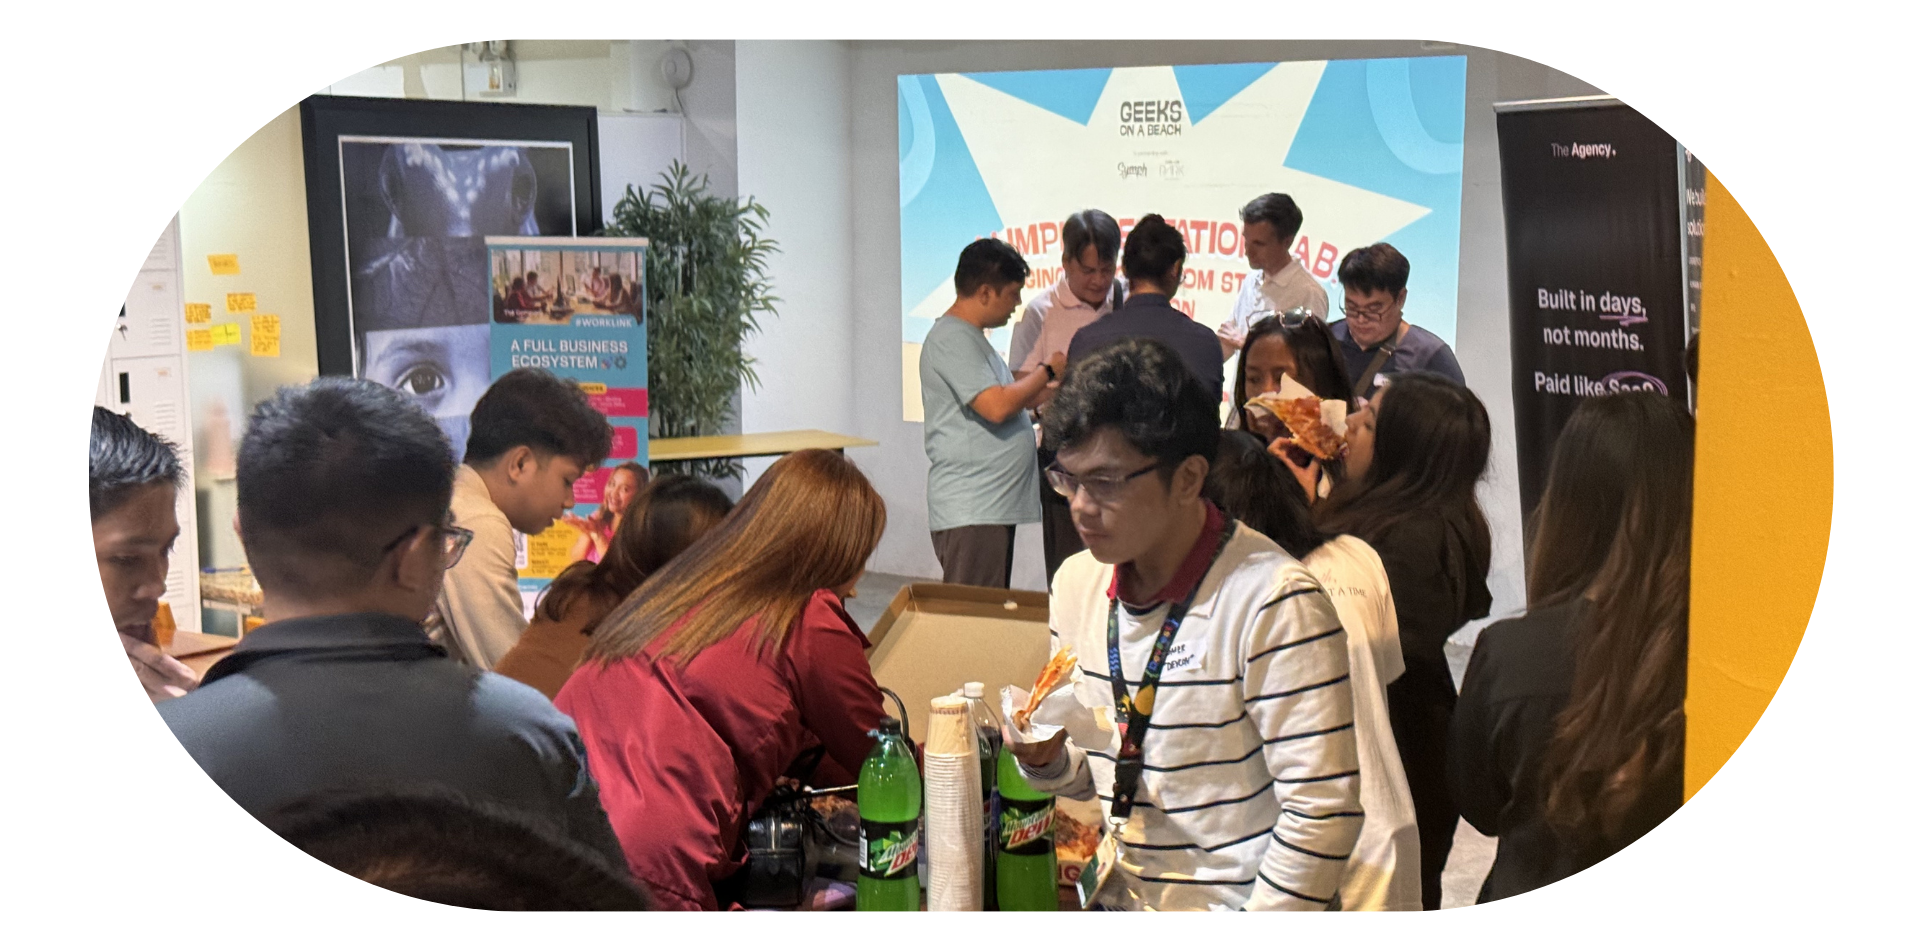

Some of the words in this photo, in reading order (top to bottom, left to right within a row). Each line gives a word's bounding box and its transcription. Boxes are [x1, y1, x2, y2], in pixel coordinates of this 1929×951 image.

[1120, 100, 1182, 123] GEEKS
[1120, 124, 1135, 136] ON
[1137, 124, 1145, 136] A
[1147, 124, 1182, 136] BEACH
[1551, 142, 1569, 157] The
[1571, 142, 1617, 159] Agency.
[1294, 235, 1338, 284] AB.
[1537, 288, 1577, 311] Built
[1580, 290, 1596, 312] in
[1599, 291, 1647, 317] days,
[575, 318, 633, 328] #WORKLINK
[510, 339, 520, 352] A
[523, 340, 557, 353] FULL
[559, 340, 629, 354] BUSINESS
[1543, 326, 1571, 345] not
[1574, 328, 1645, 352] months.
[511, 355, 598, 369] ECOSYSTEM
[1534, 371, 1571, 395] Paid
[1574, 375, 1604, 397] like
